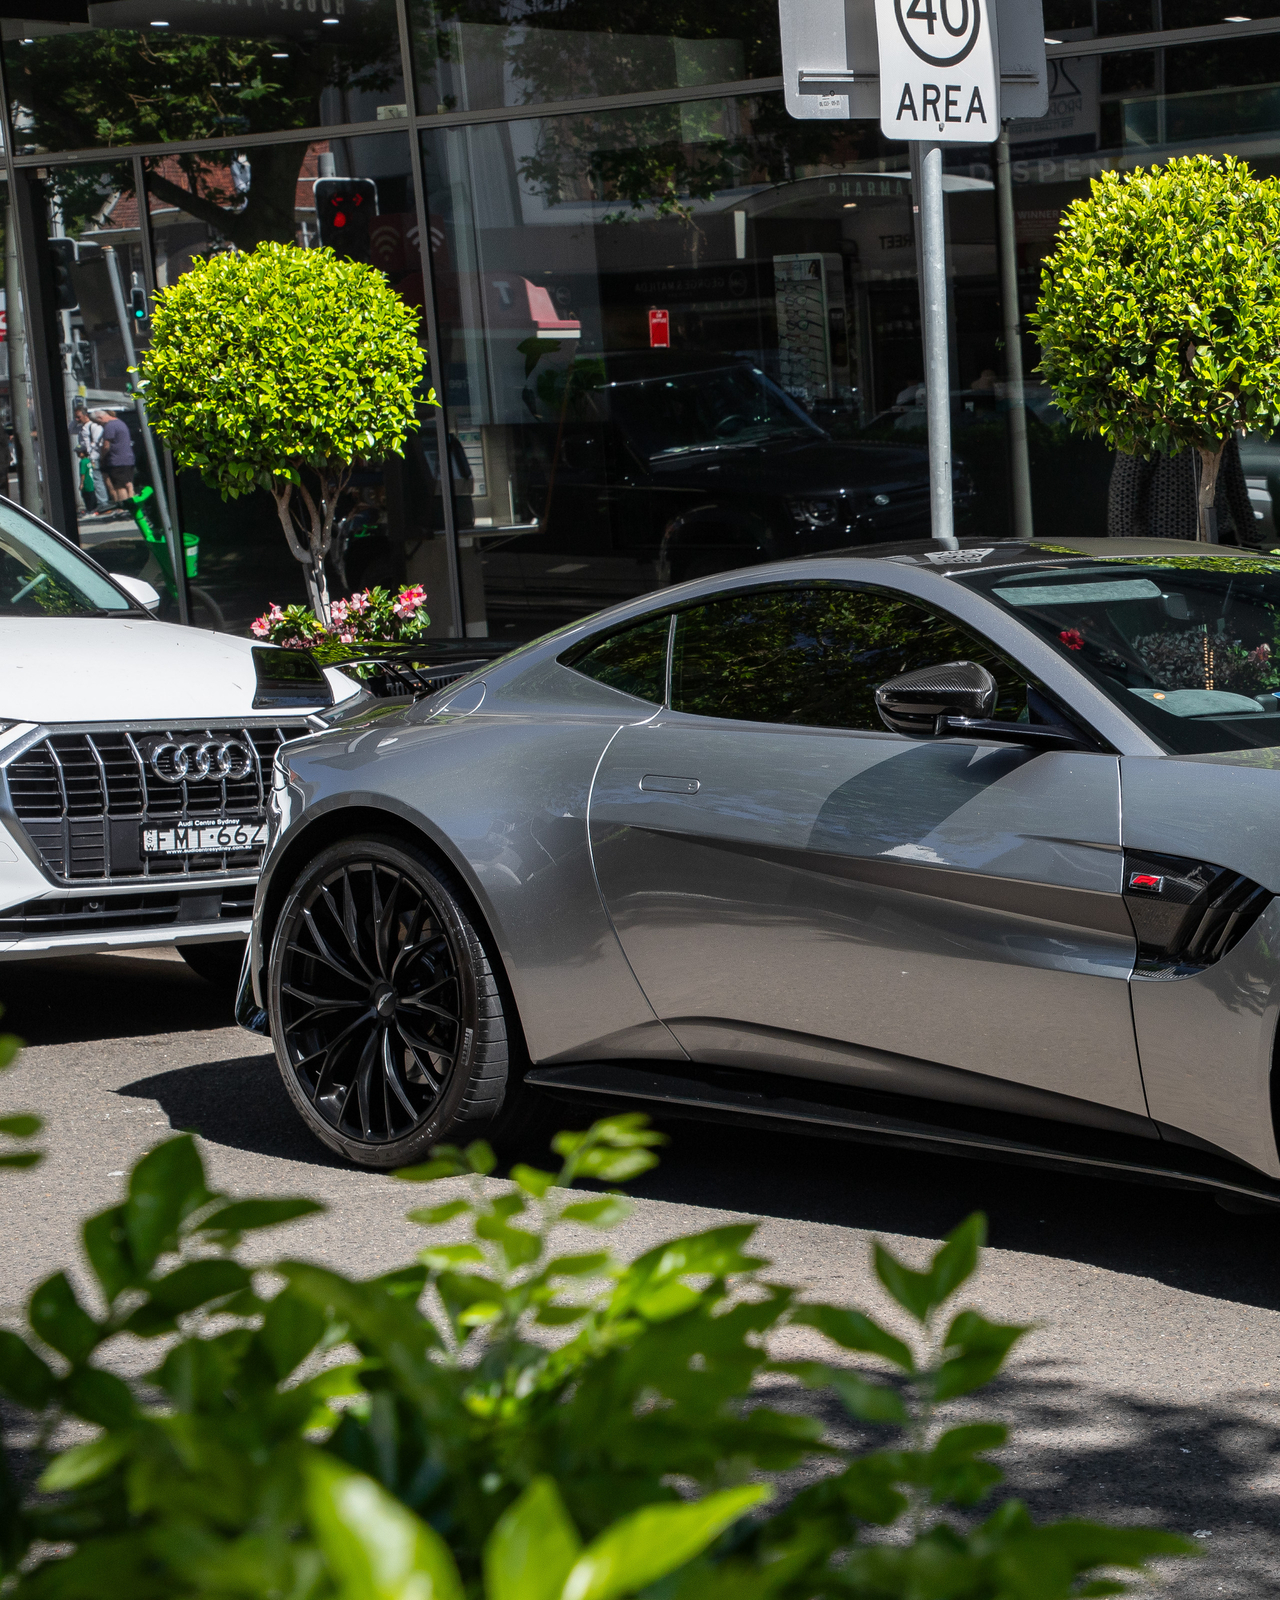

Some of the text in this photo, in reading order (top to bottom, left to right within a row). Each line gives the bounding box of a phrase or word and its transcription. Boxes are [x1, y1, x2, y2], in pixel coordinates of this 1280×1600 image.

[906, 0, 968, 37] 40
[896, 83, 987, 123] AREA
[969, 154, 1130, 182] DSPEN
[829, 181, 912, 197] PHARMA
[1017, 210, 1059, 219] WINNER
[217, 818, 240, 826] Sydney
[166, 845, 252, 854] www.audicentresydney.com.au
